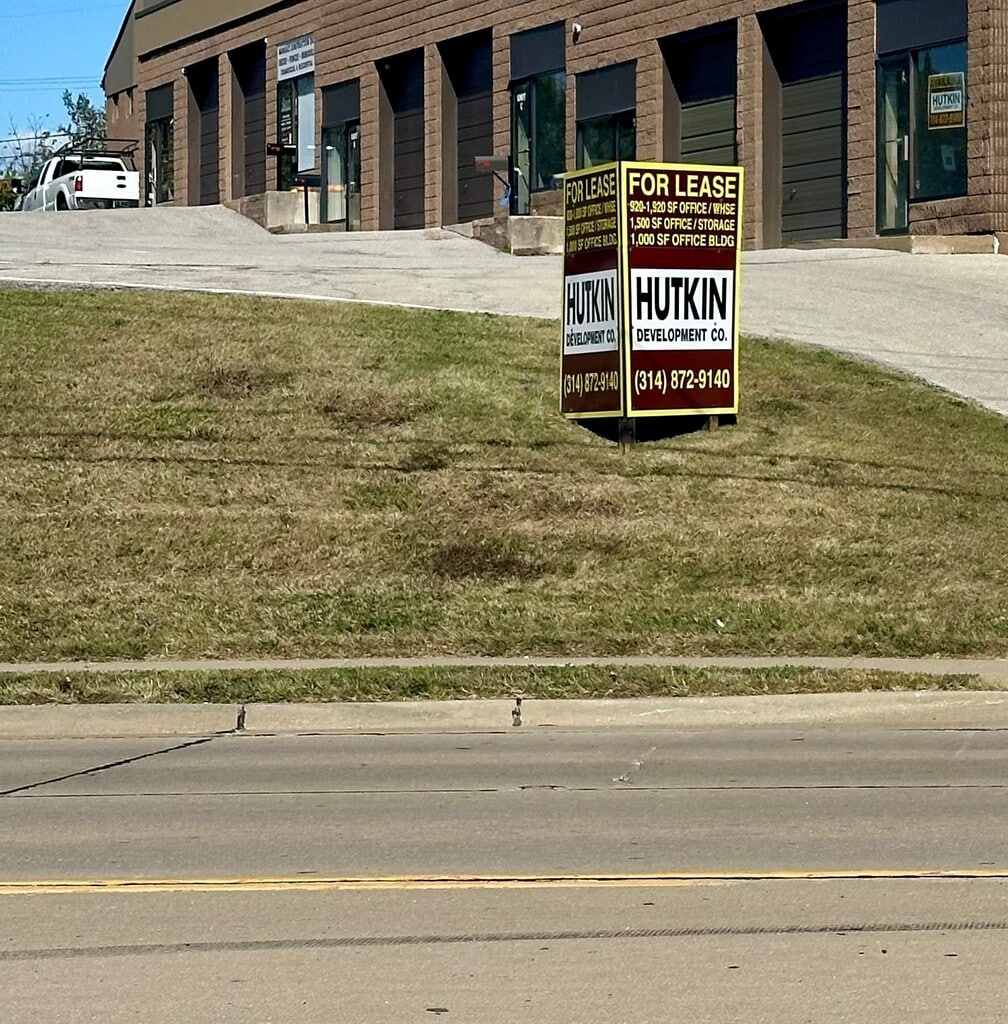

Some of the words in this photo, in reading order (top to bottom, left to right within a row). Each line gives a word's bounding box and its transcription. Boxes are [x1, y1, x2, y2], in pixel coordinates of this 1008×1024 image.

[933, 92, 960, 105] HUTKIN
[566, 180, 584, 204] FOR
[585, 173, 616, 200] LEASE
[629, 172, 669, 196] FOR
[675, 174, 736, 199] LEASE
[667, 201, 678, 213] SF
[679, 201, 707, 214] OFFICE
[712, 202, 736, 215] WHSE
[630, 217, 650, 231] 1,500
[651, 217, 663, 229] SF
[664, 217, 693, 230] OFFICE
[698, 219, 736, 231] STORAGE
[577, 238, 584, 251] SF
[584, 235, 602, 250] OFFICE
[630, 233, 655, 247] 1,000
[656, 233, 670, 246] SF
[672, 234, 706, 246] OFFICE
[708, 234, 735, 247] BLDG
[566, 277, 615, 326] HUTKIN
[636, 276, 727, 321] HUTKIN
[566, 330, 605, 347] DEVELOPMENT
[606, 329, 616, 343] CO.
[636, 328, 707, 342] DEVELOPMENT
[711, 328, 727, 342] CO.
[563, 373, 583, 398] (314)
[584, 370, 619, 393] 872-9140
[634, 369, 667, 396] (314)
[671, 369, 730, 389] 872-9140
